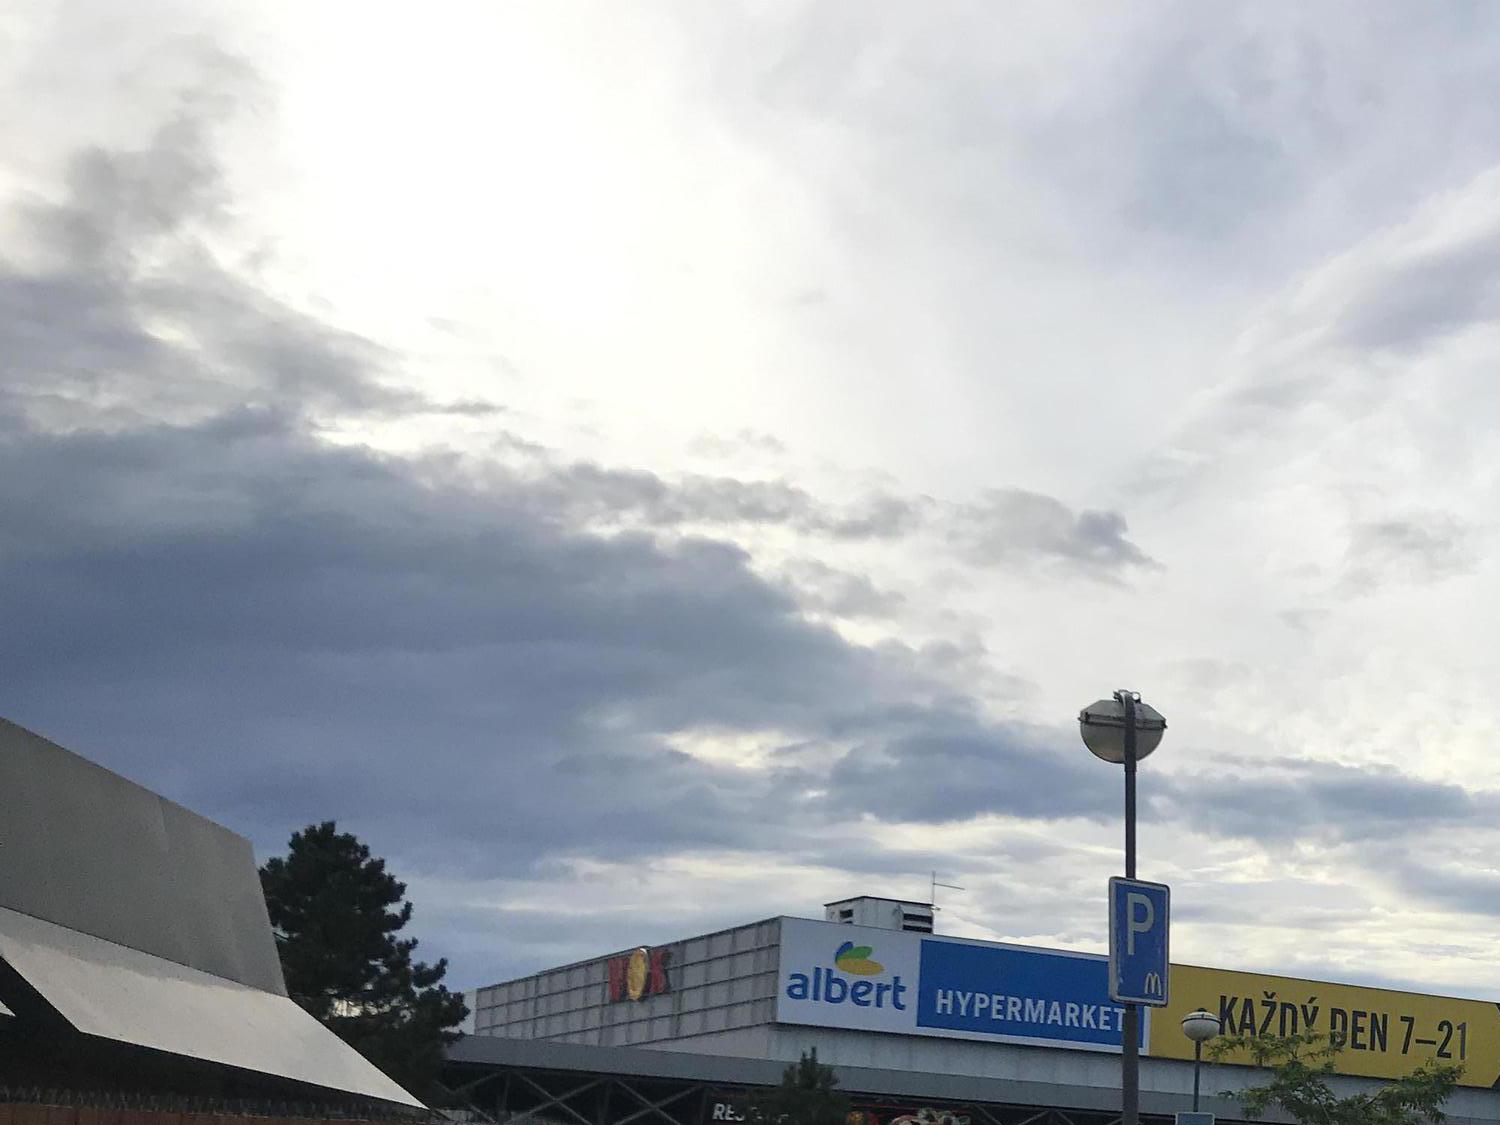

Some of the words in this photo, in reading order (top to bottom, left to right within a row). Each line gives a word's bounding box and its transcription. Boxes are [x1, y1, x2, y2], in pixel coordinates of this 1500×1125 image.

[1127, 892, 1155, 956] P
[786, 966, 907, 1011] albert
[935, 989, 1126, 1032] HYPERMARKET
[1219, 990, 1320, 1040] KAŽDÝ
[1330, 1007, 1389, 1053] DEN
